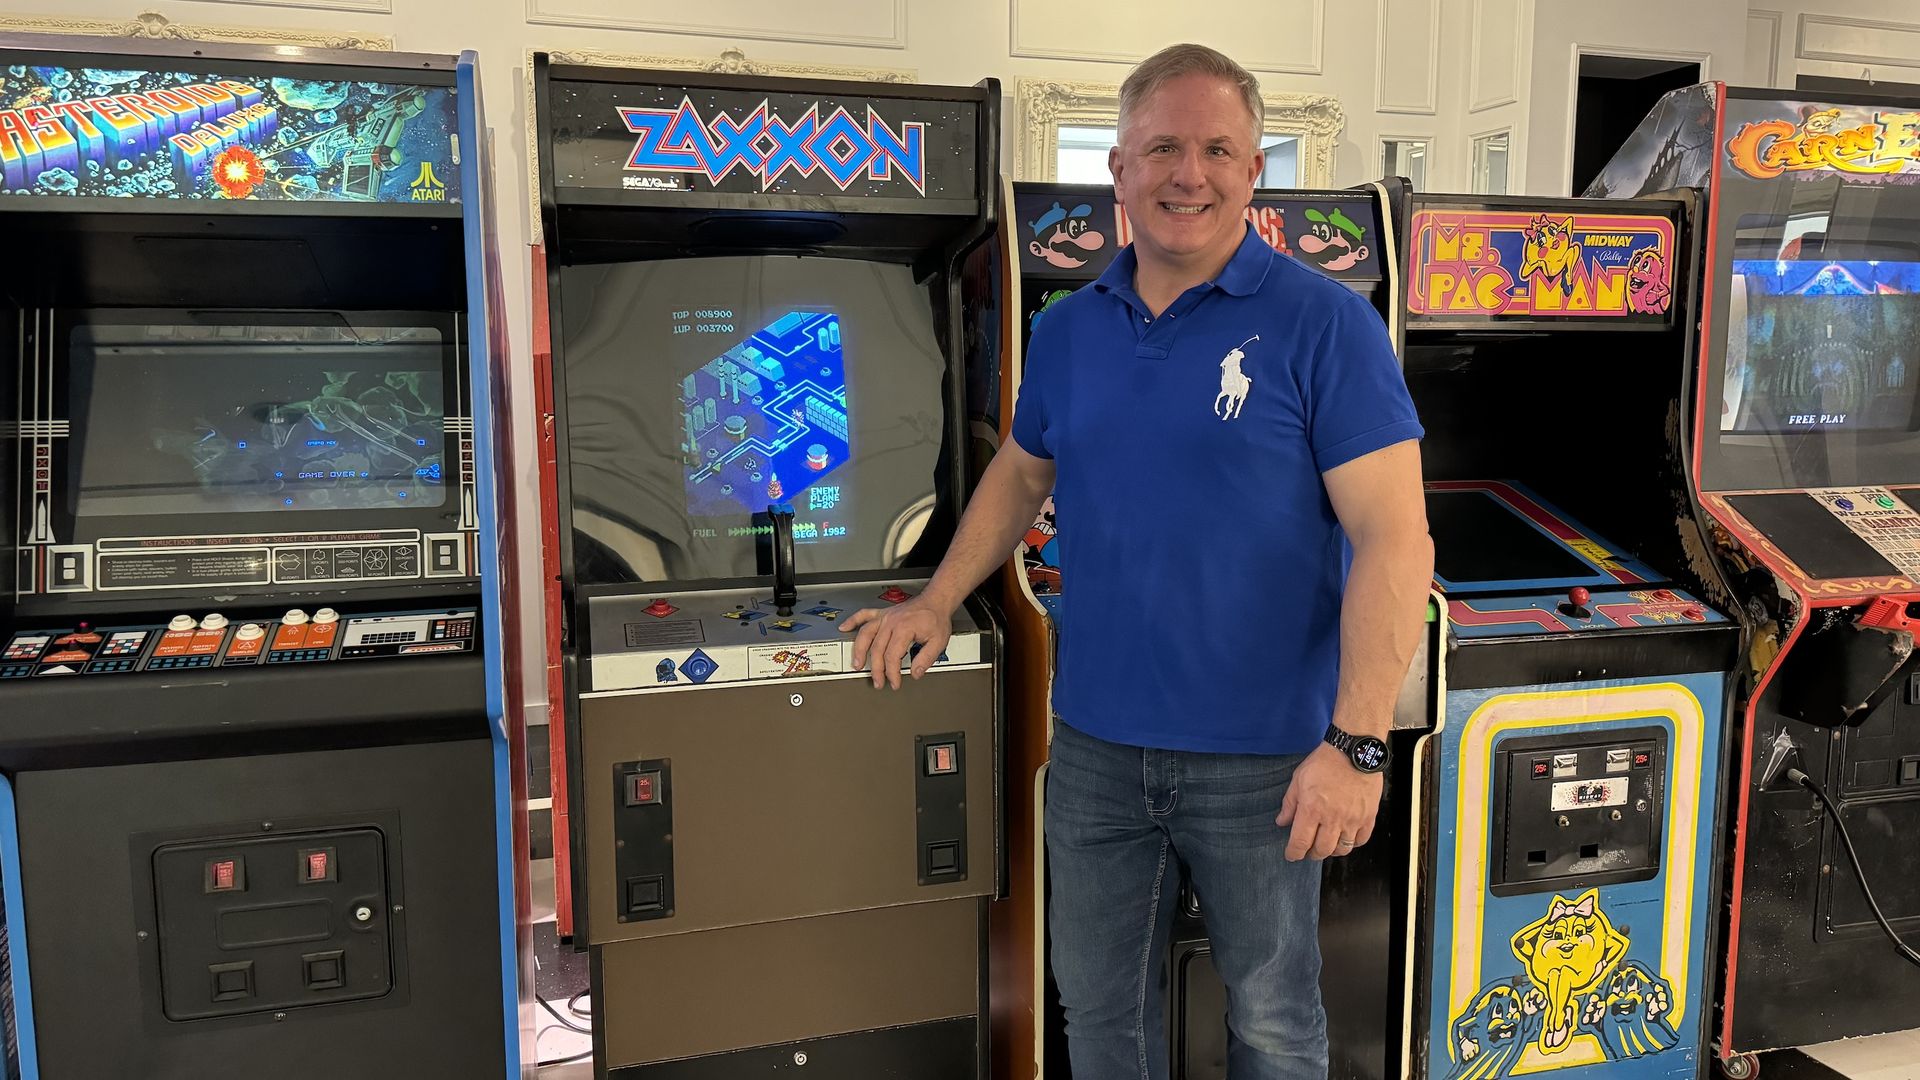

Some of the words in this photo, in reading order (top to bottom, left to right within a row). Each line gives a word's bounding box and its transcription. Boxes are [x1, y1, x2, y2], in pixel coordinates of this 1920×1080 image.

[0, 81, 259, 161] ASTEROIDS
[614, 94, 926, 198] ZAXXON
[412, 189, 446, 201] ATARI
[1584, 234, 1634, 248] MIDWAY
[1599, 250, 1622, 263] Bally
[1427, 268, 1626, 314] PAC-MAN
[672, 310, 690, 320] TOP
[695, 310, 733, 319] 008900
[672, 325, 691, 334] 1UP
[696, 324, 734, 333] 003700
[1788, 414, 1816, 426] FREE
[1819, 414, 1847, 425] PLAY
[298, 471, 324, 479] GAME
[329, 470, 356, 478] OVER
[810, 486, 840, 495] ENEMY
[810, 493, 840, 502] PLANE
[693, 528, 717, 538] FUEL
